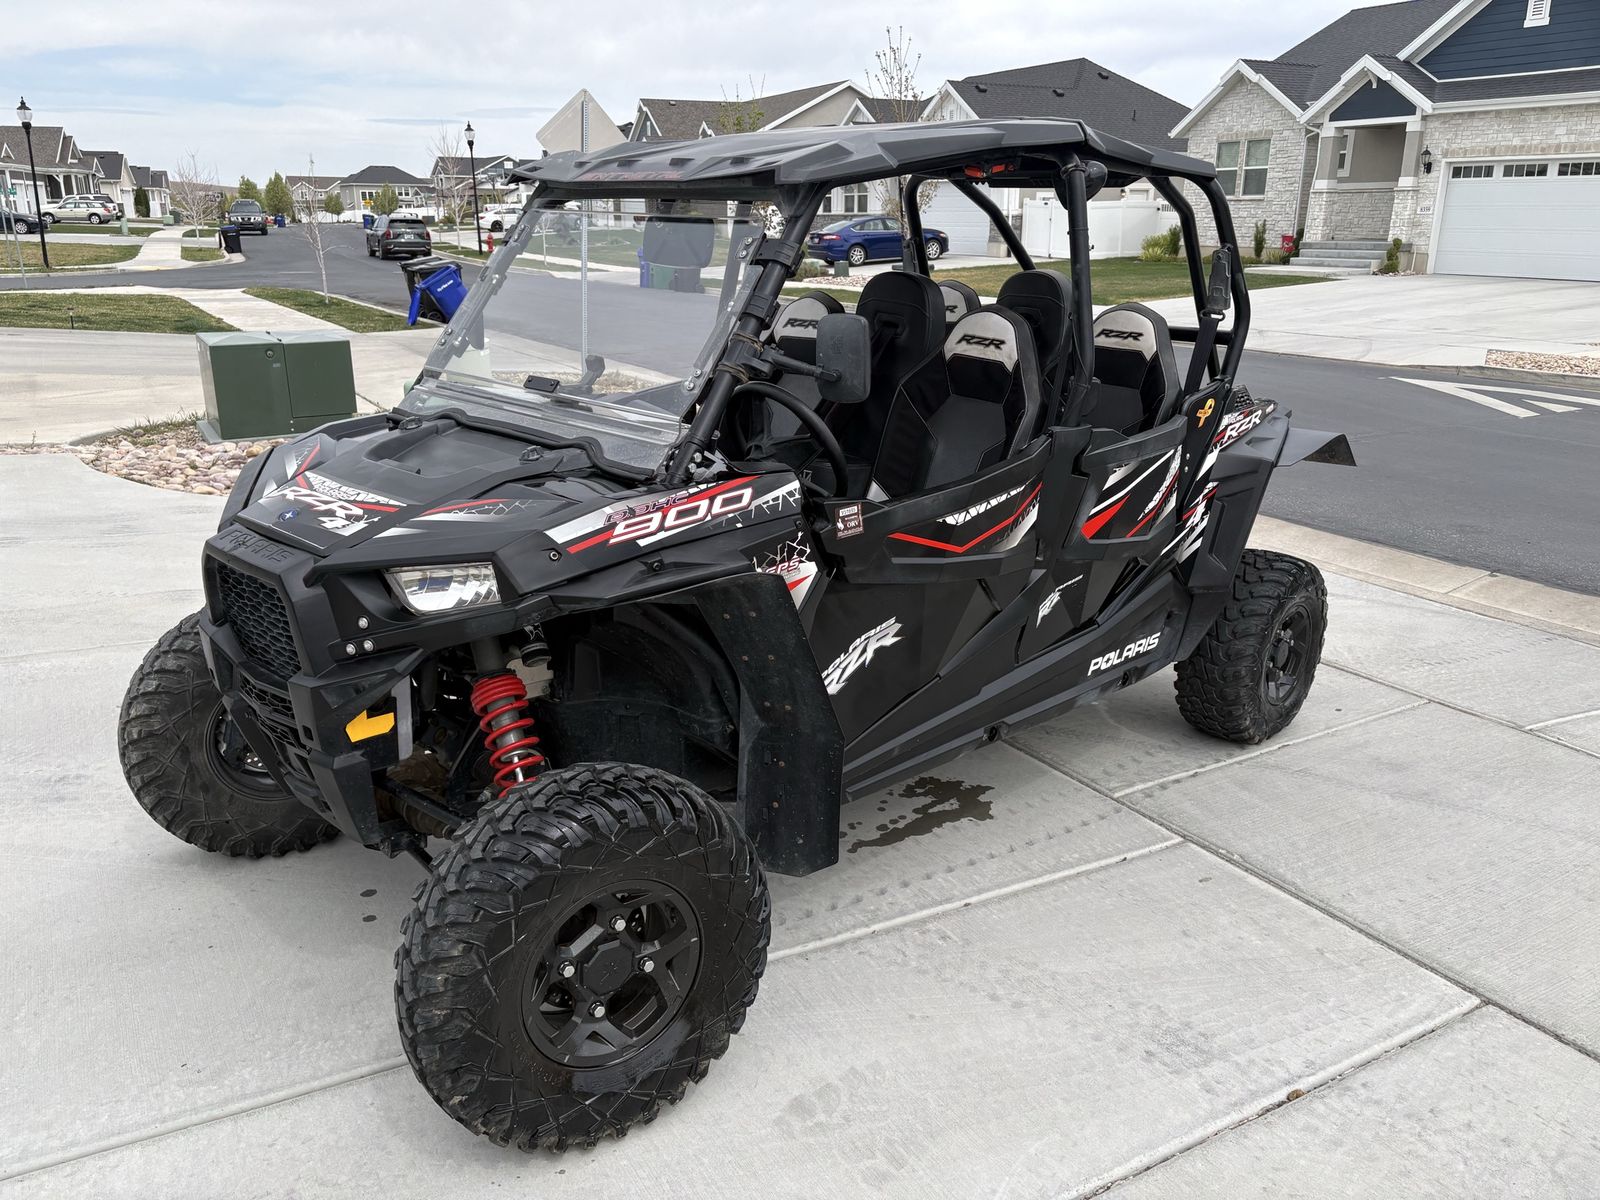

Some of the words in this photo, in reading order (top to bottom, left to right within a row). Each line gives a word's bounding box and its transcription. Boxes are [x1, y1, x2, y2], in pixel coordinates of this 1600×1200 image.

[782, 317, 818, 330] RZR
[1094, 328, 1144, 341] RZR
[955, 333, 1006, 351] RZR
[1222, 409, 1263, 444] RZR
[264, 485, 365, 520] RZR
[607, 486, 754, 546] 900
[317, 516, 352, 531] 4
[764, 556, 801, 575] EPS
[823, 622, 905, 696] RZR
[1087, 631, 1161, 677] POLARIS
